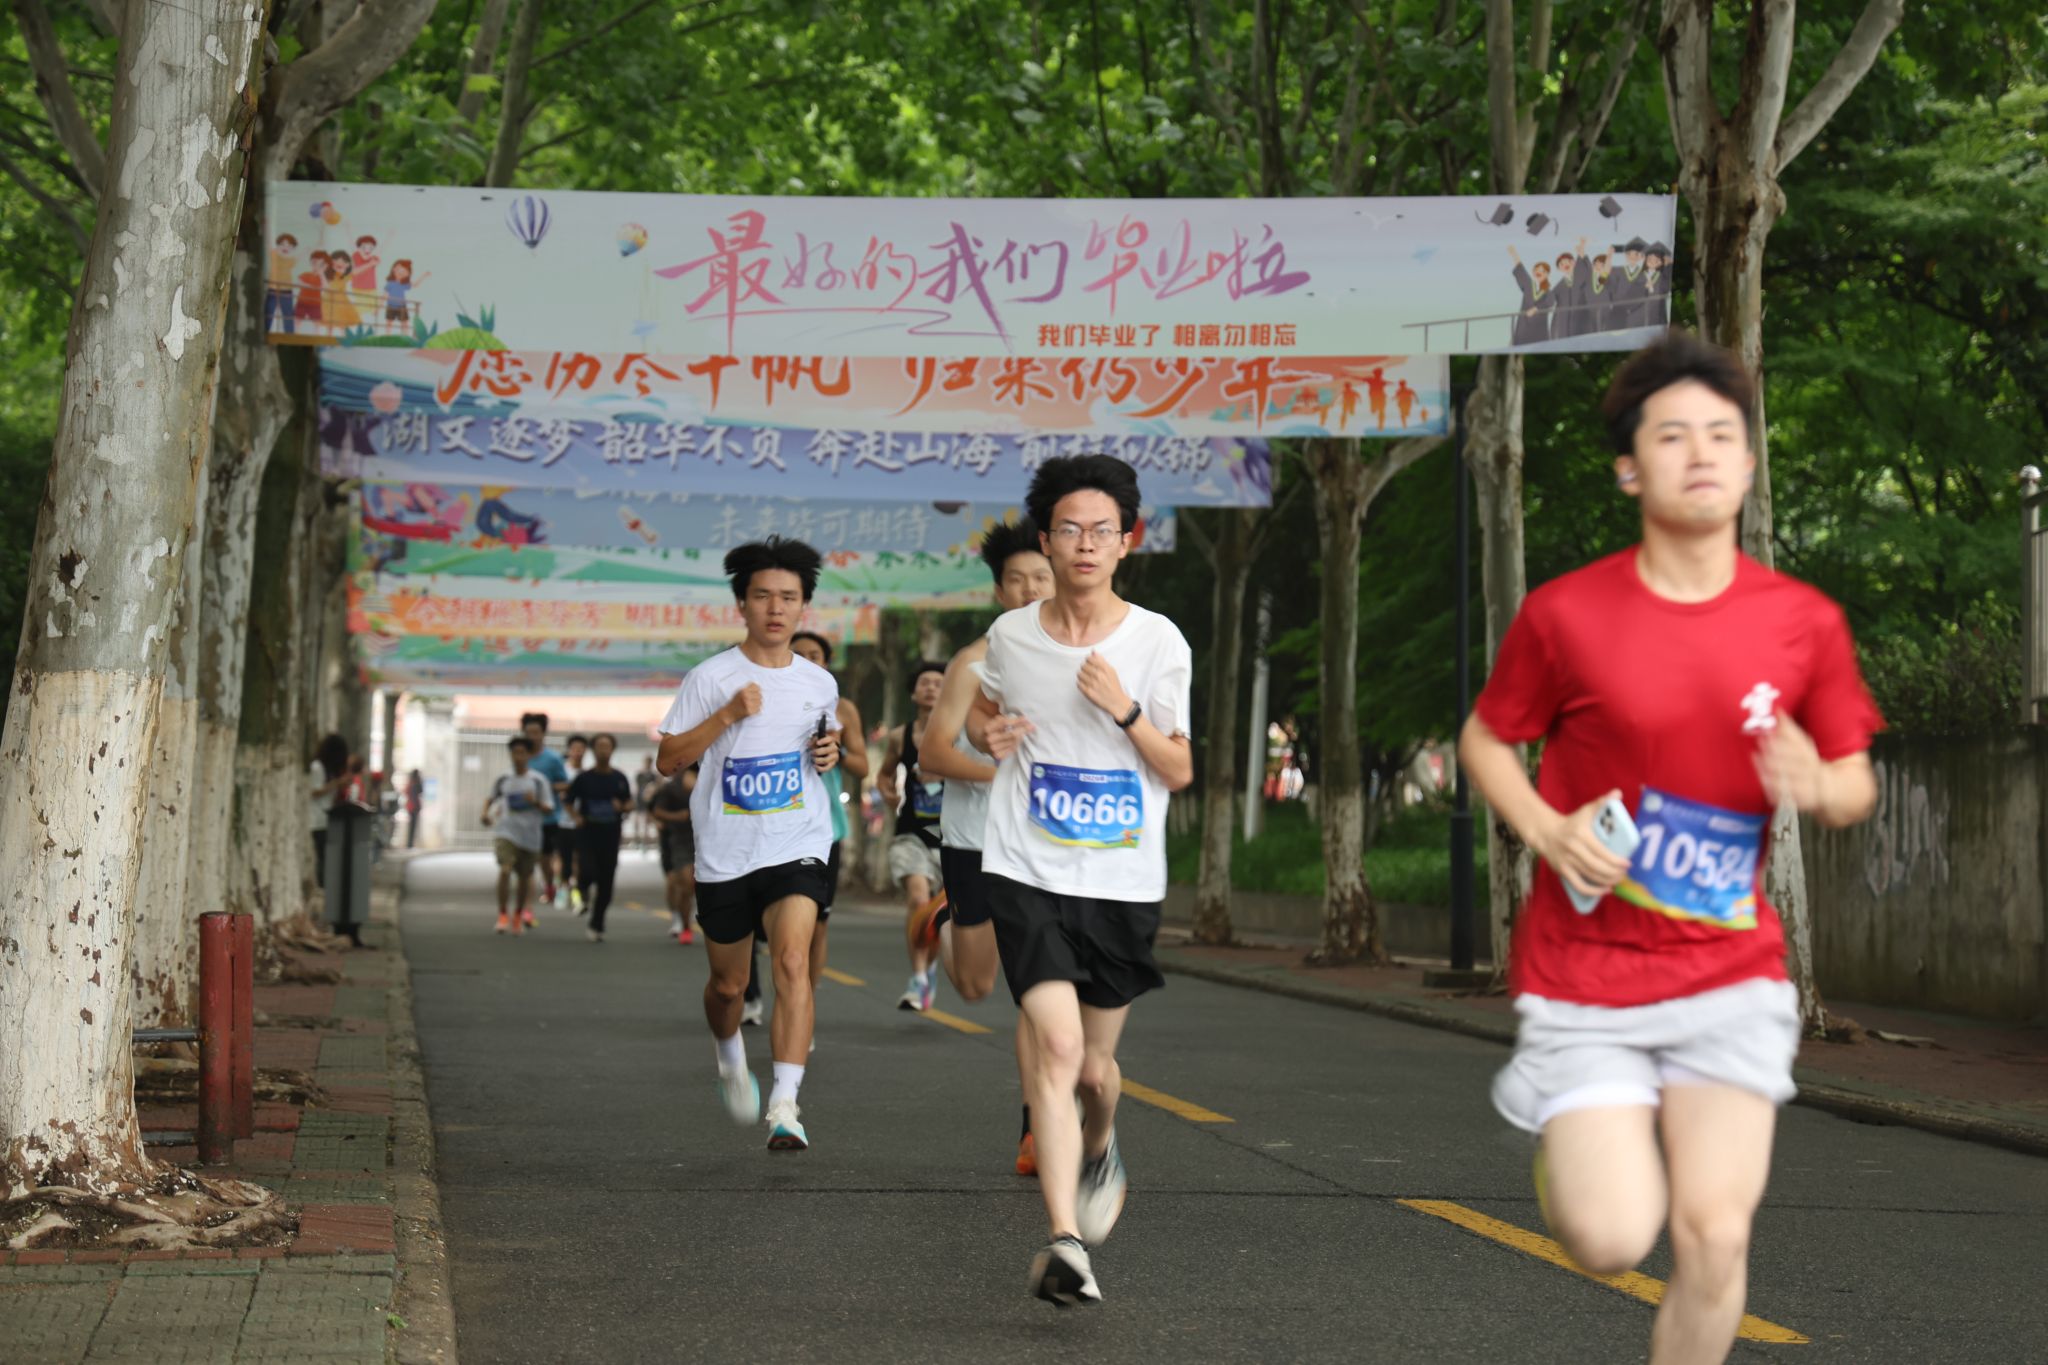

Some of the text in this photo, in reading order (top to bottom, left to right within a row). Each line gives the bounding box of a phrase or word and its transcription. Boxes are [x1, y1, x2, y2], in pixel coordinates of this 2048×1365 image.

[655, 209, 1310, 350] 最好的我们毕业啦
[1038, 323, 1297, 347] 我们毕业了 相离勿相忘
[381, 408, 583, 467] 湖文逐梦
[595, 422, 786, 474] 韶华不负
[804, 428, 1002, 478] 奔赴山海
[726, 768, 801, 797] 10078
[1033, 787, 1139, 826] 10666
